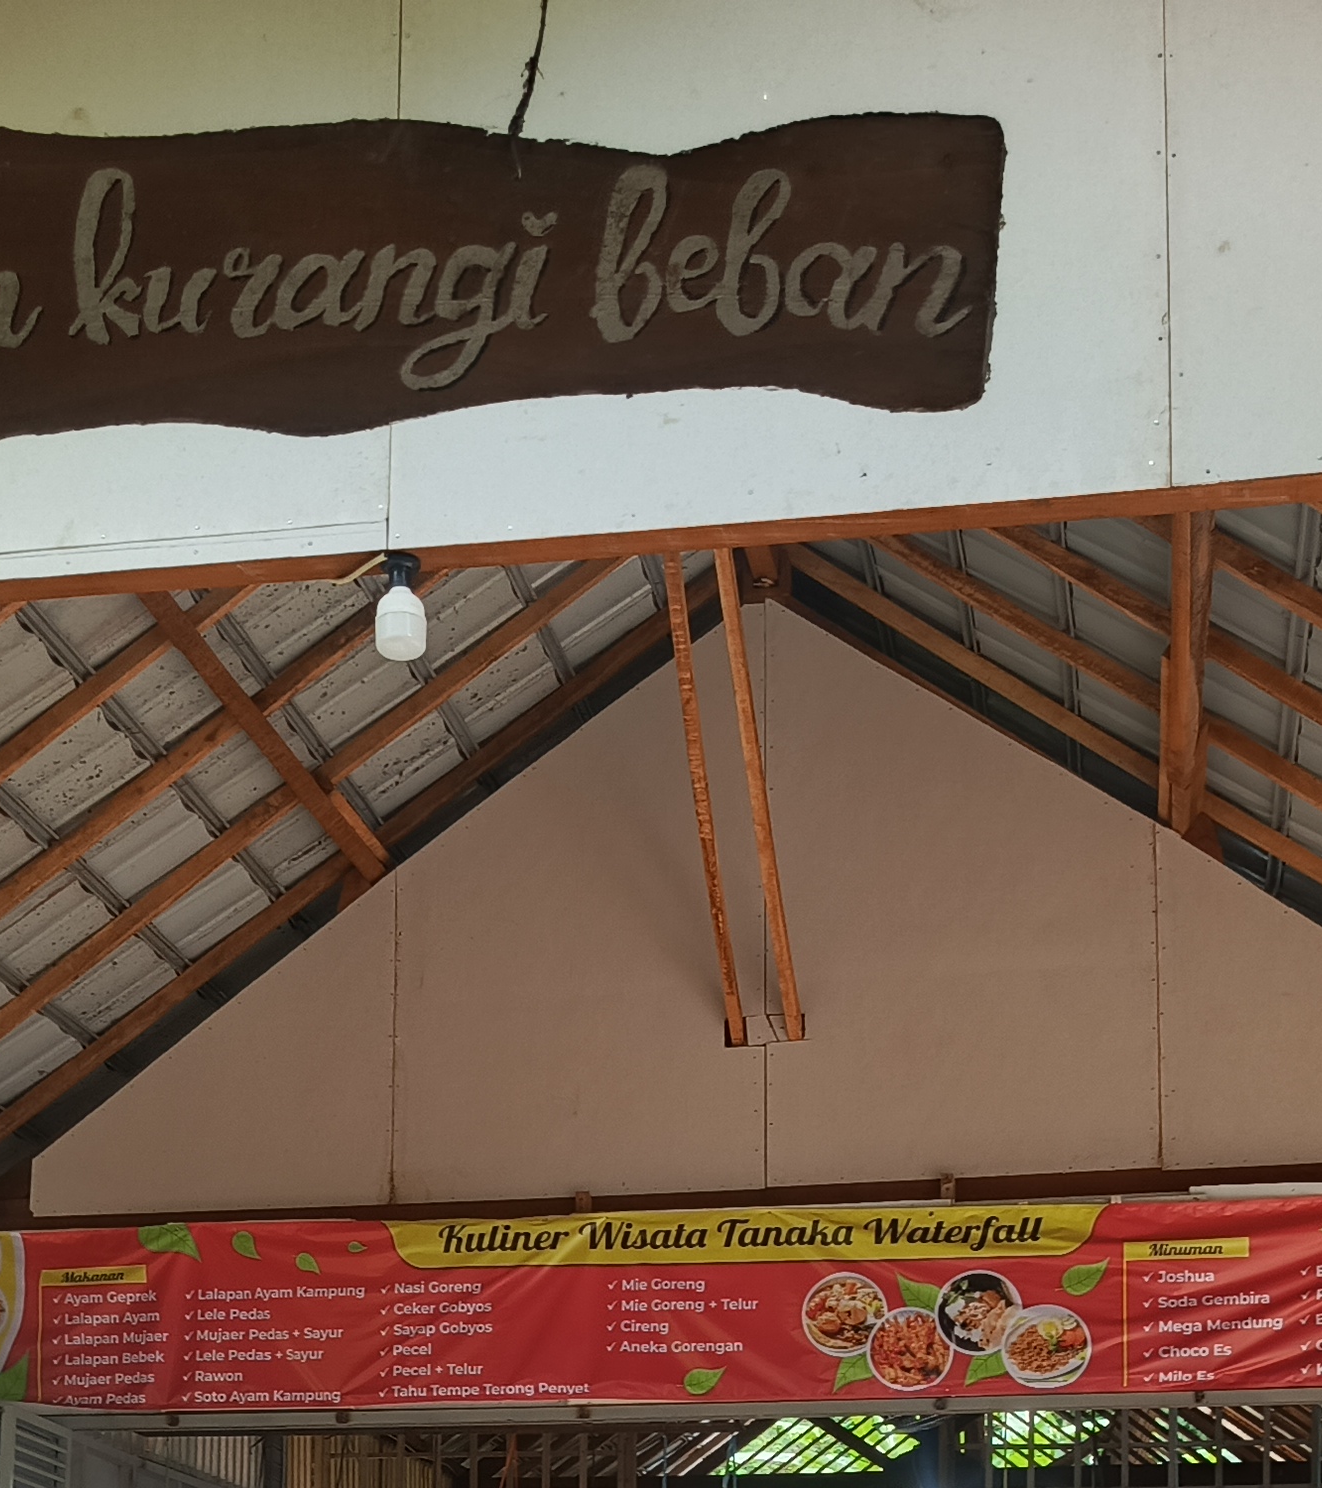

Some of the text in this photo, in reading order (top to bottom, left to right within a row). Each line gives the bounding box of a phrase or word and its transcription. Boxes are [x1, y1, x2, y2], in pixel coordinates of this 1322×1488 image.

[68, 168, 559, 391] kurangi
[590, 165, 973, 343] beban
[439, 1216, 1042, 1253] Kuliner Wisata Tanaka Waterfall
[1149, 1244, 1223, 1256] Minuman
[60, 1272, 124, 1283] Makanan
[1158, 1270, 1215, 1283] Joshua
[395, 1281, 481, 1294] Nasi Goreng
[622, 1278, 705, 1292] Mie Goreng
[64, 1290, 156, 1306] Ayam Geprek
[198, 1287, 365, 1302] Lalapan Ayam Kampung
[1158, 1292, 1270, 1308] Soda Gembira
[394, 1301, 491, 1315] Ceker Gobyos
[622, 1299, 647, 1311] Mie
[651, 1299, 704, 1312] Goreng
[721, 1298, 758, 1310] Telur
[65, 1311, 160, 1327] Lalapan Ayam
[198, 1308, 270, 1320] Lele Pedas
[394, 1322, 492, 1337] Sayap Gobyos
[621, 1320, 668, 1334] Cireng
[1159, 1318, 1283, 1334] Mega Mendung
[65, 1330, 169, 1347] Lalapan Mujaer
[197, 1328, 245, 1343] Mujaer
[249, 1328, 289, 1340] Pedas
[304, 1327, 343, 1341] Sayur
[393, 1343, 431, 1355] Pecel
[620, 1341, 742, 1354] Aneka Gorengan
[1159, 1344, 1232, 1357] Choco Es
[65, 1350, 166, 1367] Lalapan Bebek
[196, 1350, 225, 1361] Lele
[229, 1349, 271, 1360] Pedas
[286, 1349, 323, 1362] Sayur
[195, 1371, 242, 1381] Rawon
[393, 1364, 431, 1376] Pecel
[447, 1363, 483, 1375] Telur
[1159, 1371, 1214, 1382] Milo Es
[64, 1372, 155, 1388] Mujaer Pedas
[195, 1390, 340, 1404] Soto Ayam Kampung
[392, 1383, 589, 1397] Tahu Tempe Terong Penyet
[64, 1393, 146, 1405] Ayam Pedas
